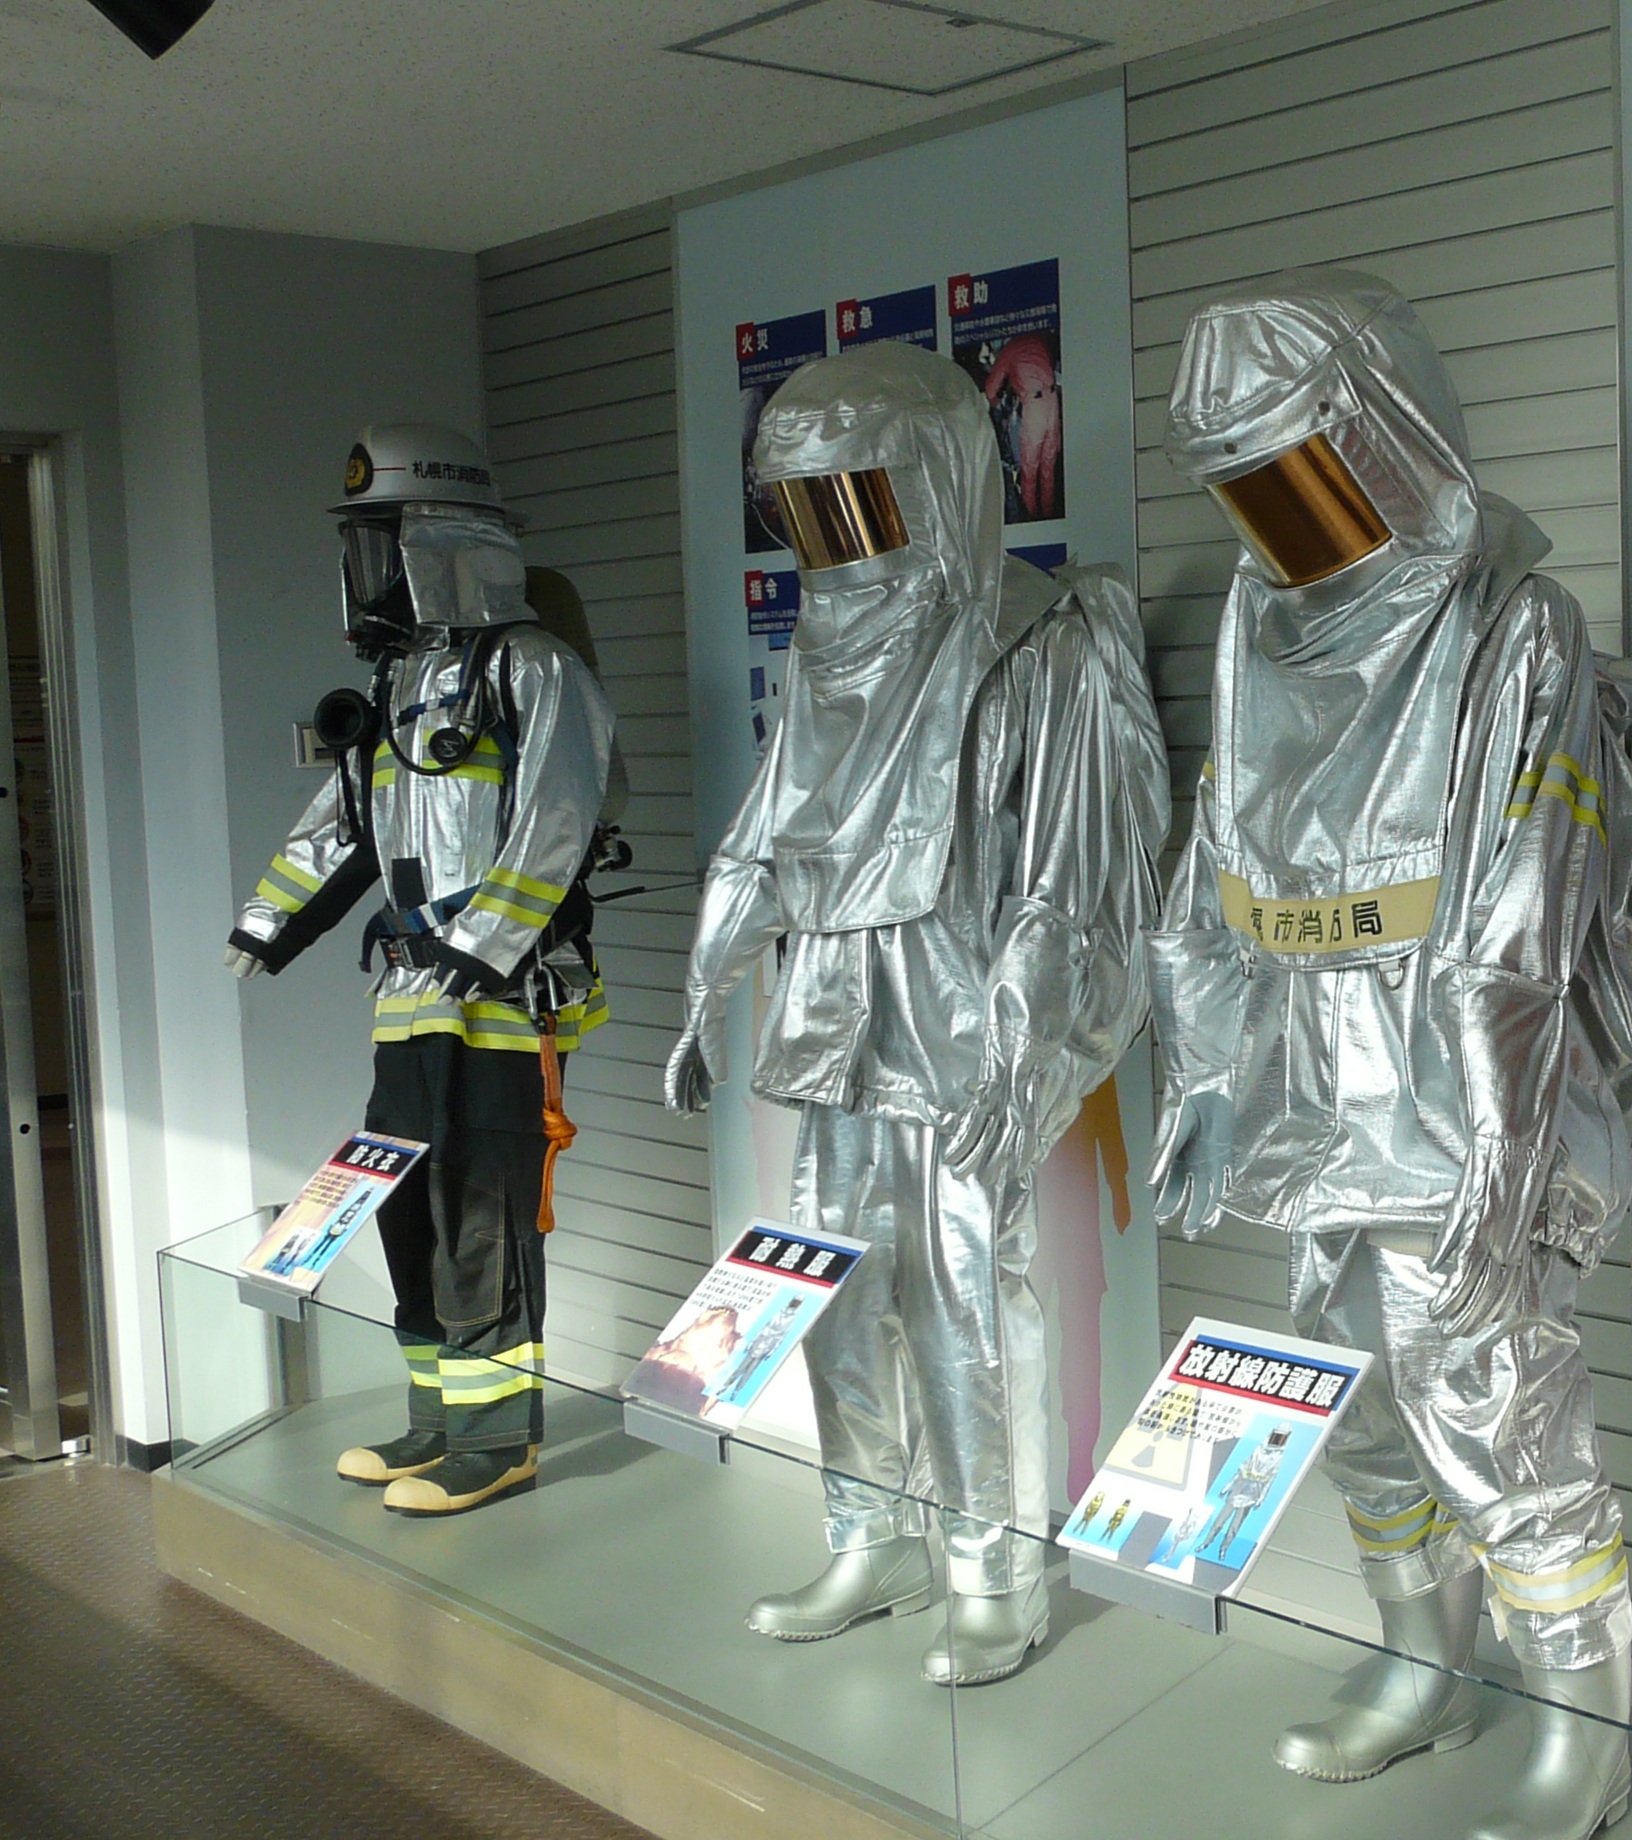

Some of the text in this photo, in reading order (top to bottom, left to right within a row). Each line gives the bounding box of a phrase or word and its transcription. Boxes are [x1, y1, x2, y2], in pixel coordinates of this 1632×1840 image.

[954, 281, 988, 310] 救助
[843, 306, 873, 333] 救急
[741, 328, 769, 354] 火災
[750, 577, 778, 601] 指令
[748, 1237, 836, 1278] 耐熱服
[1178, 1343, 1345, 1408] 放射線防護服
